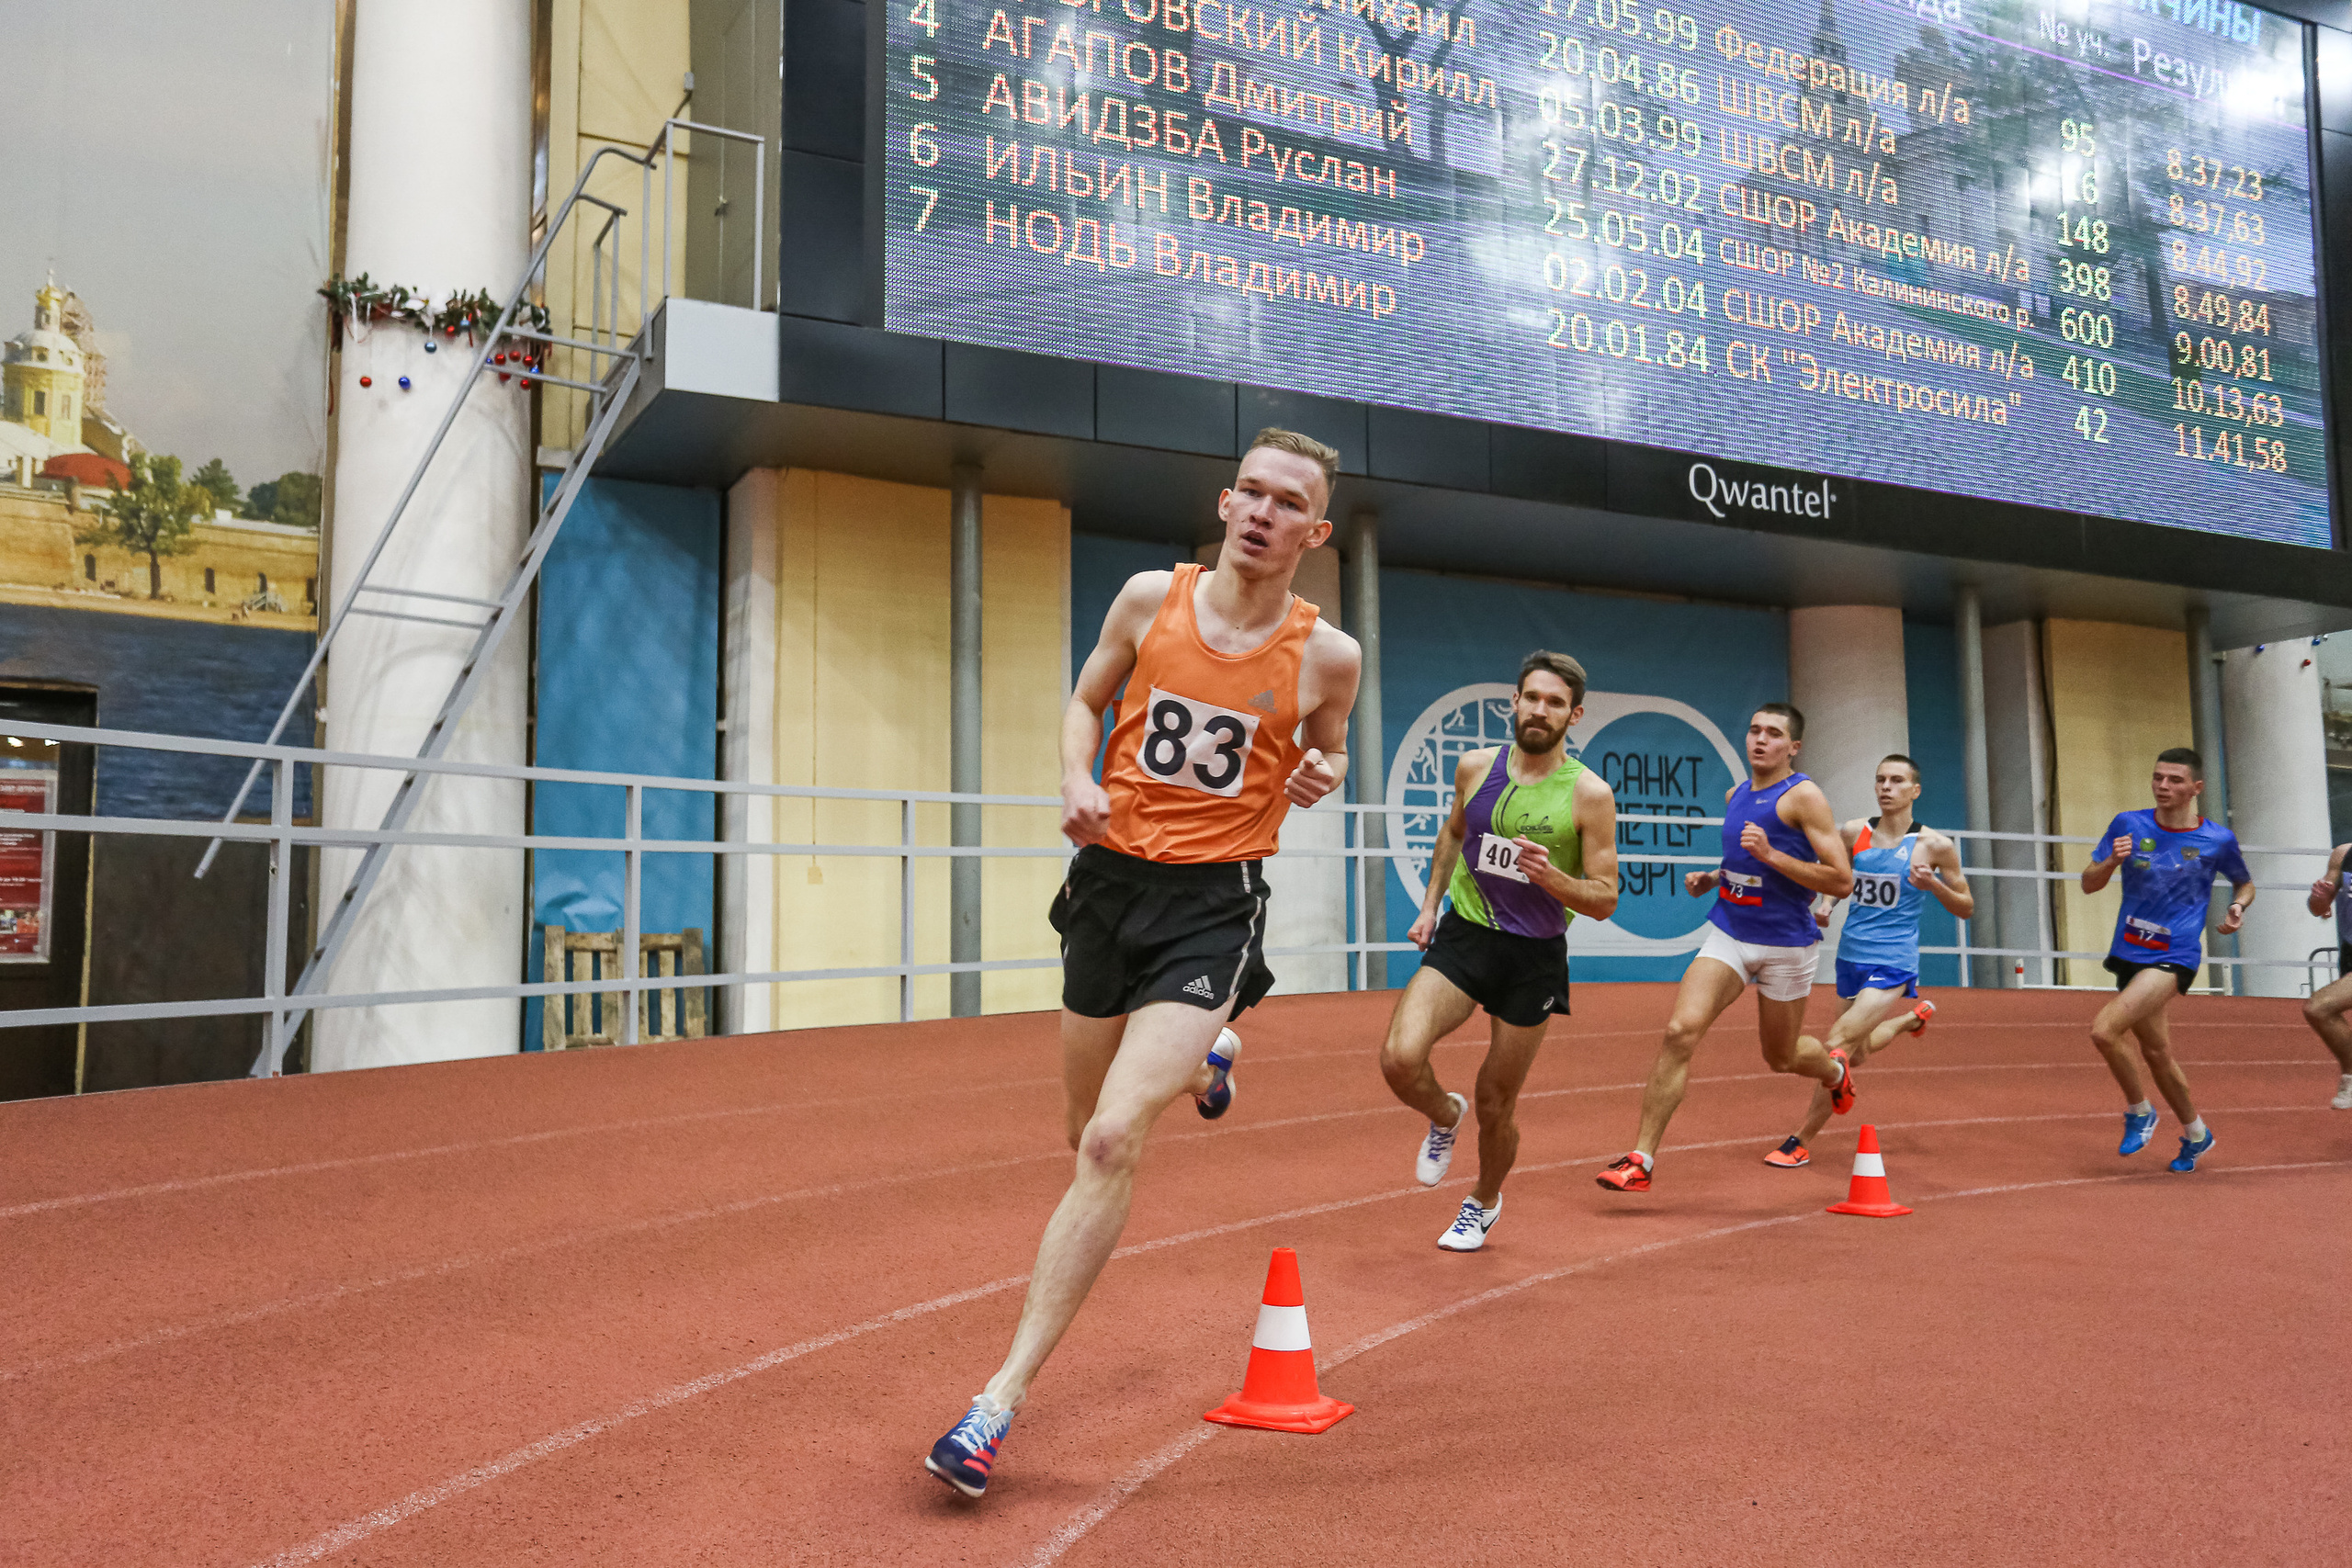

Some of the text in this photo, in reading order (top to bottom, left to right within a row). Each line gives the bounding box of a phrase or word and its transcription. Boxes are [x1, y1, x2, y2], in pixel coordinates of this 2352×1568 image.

[1320, 0, 1473, 46] ихаил
[1538, 30, 1700, 106] 20.04.86
[1718, 74, 1833, 139] ШВСМ
[1843, 112, 1897, 154] л/а
[2169, 193, 2266, 245] 8.37,63
[1714, 24, 1908, 109] Федерация
[1917, 83, 1971, 124] л/а
[2060, 118, 2097, 157] 95
[2166, 148, 2264, 201] 8.37,23
[2075, 29, 2111, 59] уч.
[2132, 38, 2229, 98] Резул
[908, 0, 2270, 336] 4 АГАПОВ Дмитрий 27.12.02 СШОР Академия л/а 398 8.49,84
[910, 55, 2273, 382] 5 АВИДЗБА Руслан 25.05.04 СШОР №2 Калининского р. 600 9.00,81
[1339, 32, 1497, 108] Кирилл
[1539, 86, 1702, 157] 05.03.99
[1719, 128, 1835, 189] ШВСМ
[1844, 162, 1898, 205] л/а
[2057, 210, 2110, 254] 148
[2172, 239, 2267, 291] 8.44,92
[909, 186, 2288, 473] 7 НОДЬ Владимир 20.01.84 СК "Электросила" 42 11.41,58
[910, 122, 2284, 427] 6 ИЛЬИН Владимир 02.02.04 СШОР Академия л/а 410 10.13,63
[1689, 463, 1830, 519] Qwantel
[1144, 699, 1247, 789] 83
[1602, 751, 1703, 798] САНКТ
[1729, 882, 1744, 898] 73
[1853, 877, 1896, 907] 430
[1182, 986, 1215, 999] adidas
